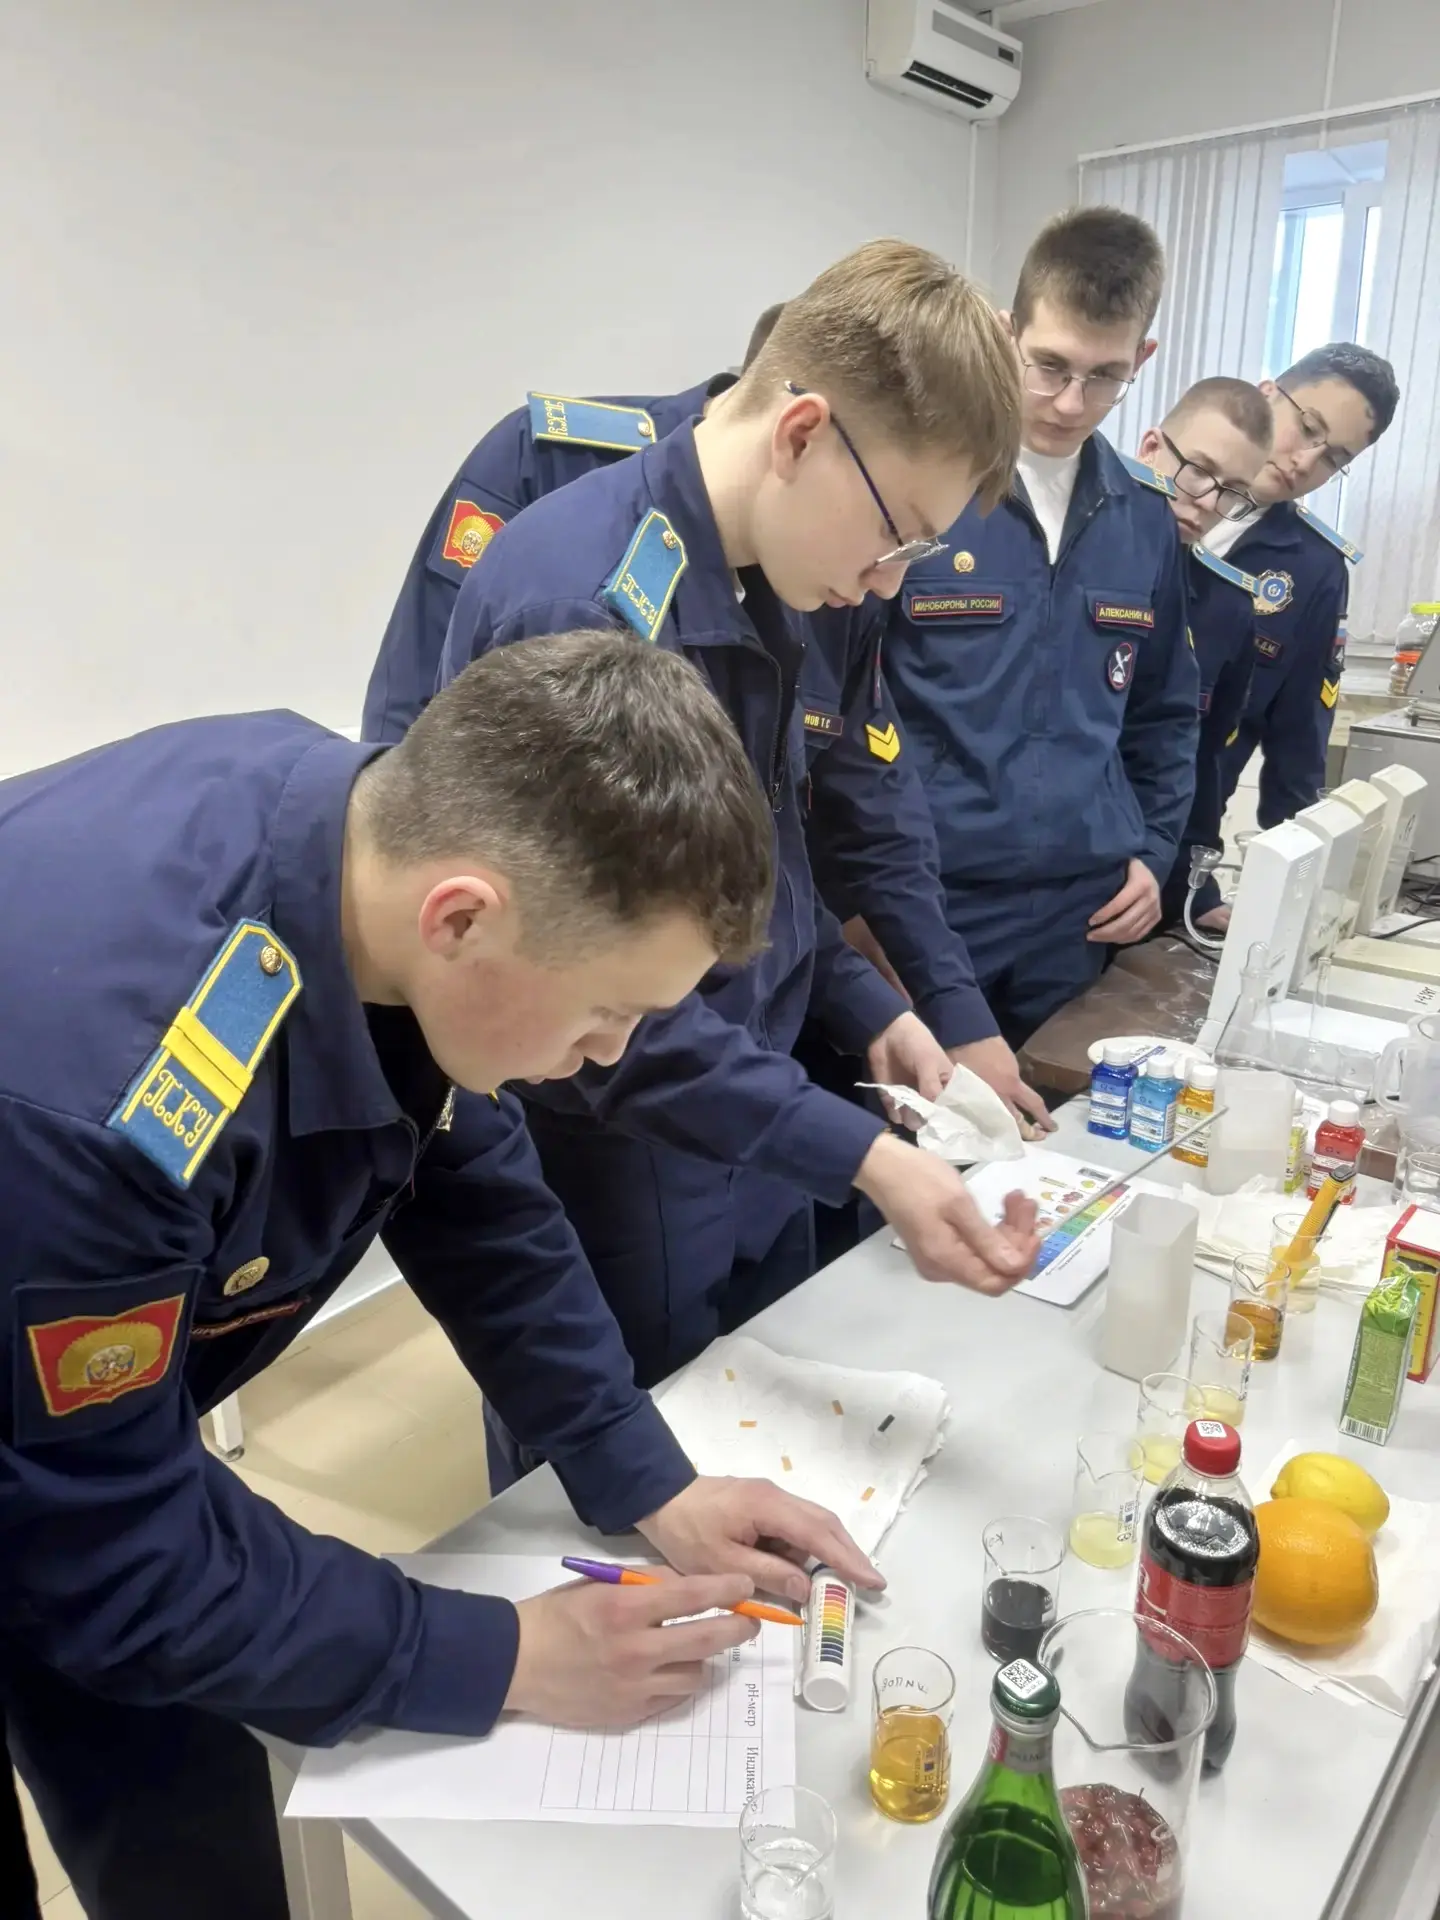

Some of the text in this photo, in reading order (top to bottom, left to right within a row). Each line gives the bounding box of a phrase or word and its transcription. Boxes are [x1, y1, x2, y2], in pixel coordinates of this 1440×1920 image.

[914, 599, 1000, 613] МИНОБОРОНЫ РОССИИ
[142, 1069, 214, 1148] ПКУ
